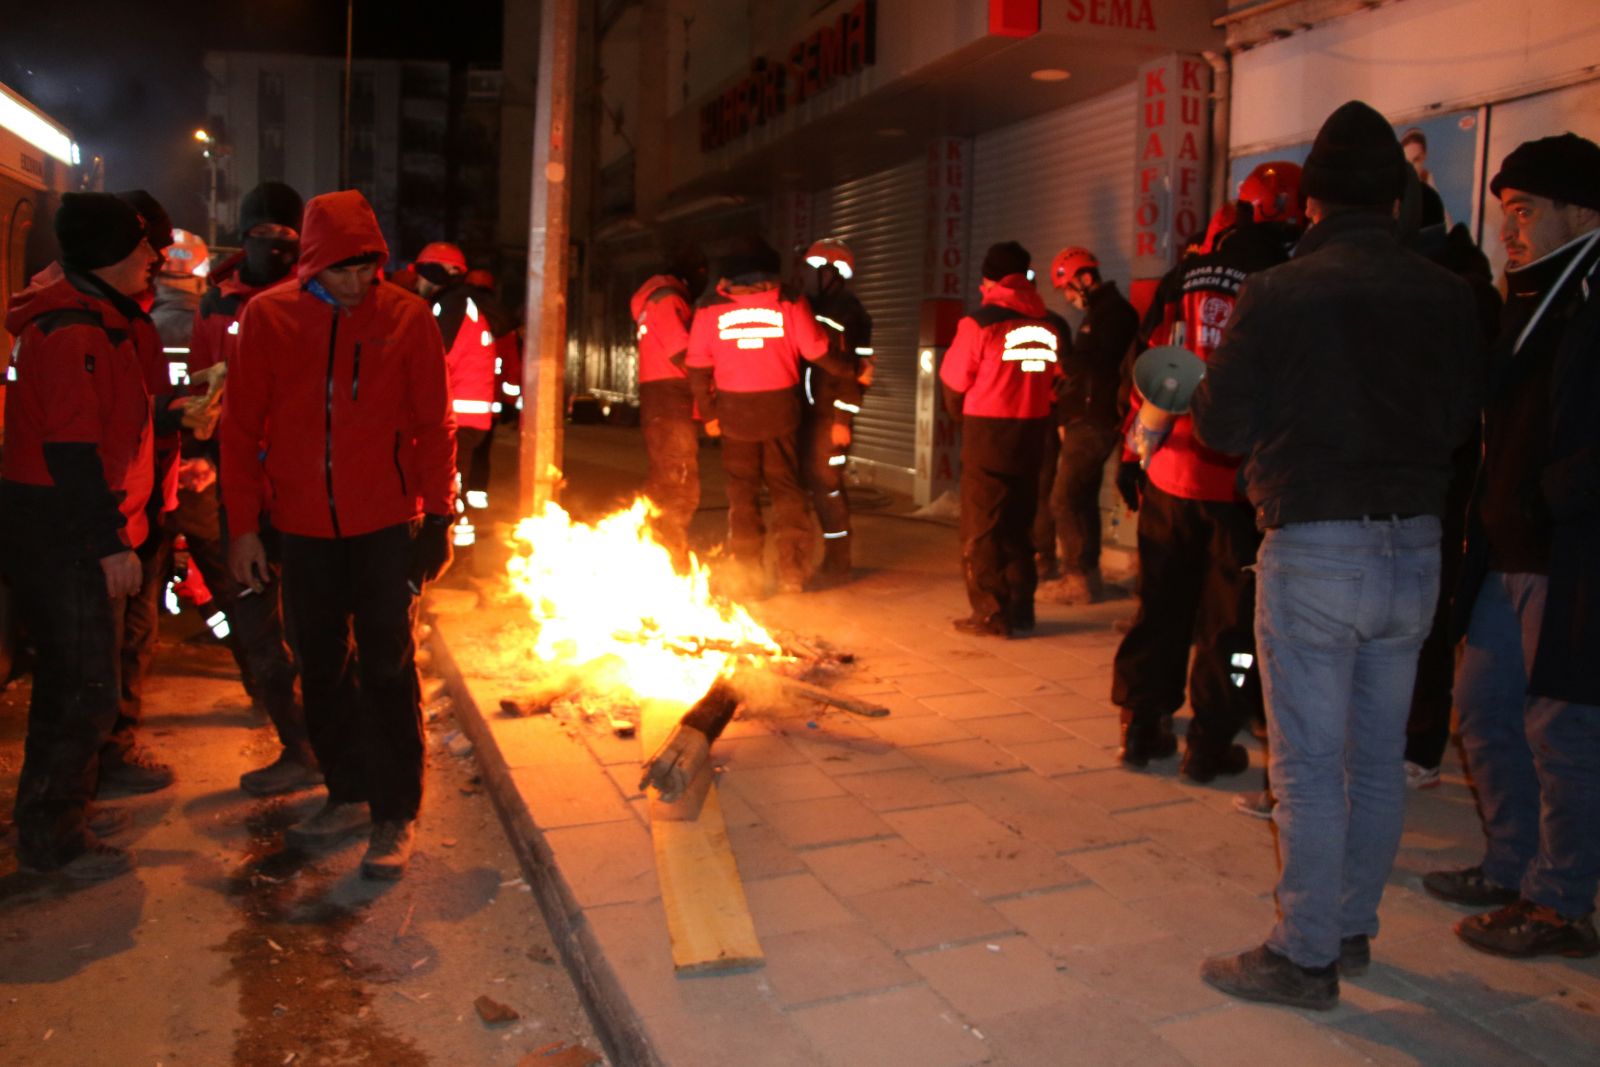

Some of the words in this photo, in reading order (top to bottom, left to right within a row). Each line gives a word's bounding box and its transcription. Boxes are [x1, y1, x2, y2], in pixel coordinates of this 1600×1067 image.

[786, 0, 876, 104] SEMA
[1067, 0, 1156, 31] SEMA
[1135, 67, 1166, 257] KUAFÖR
